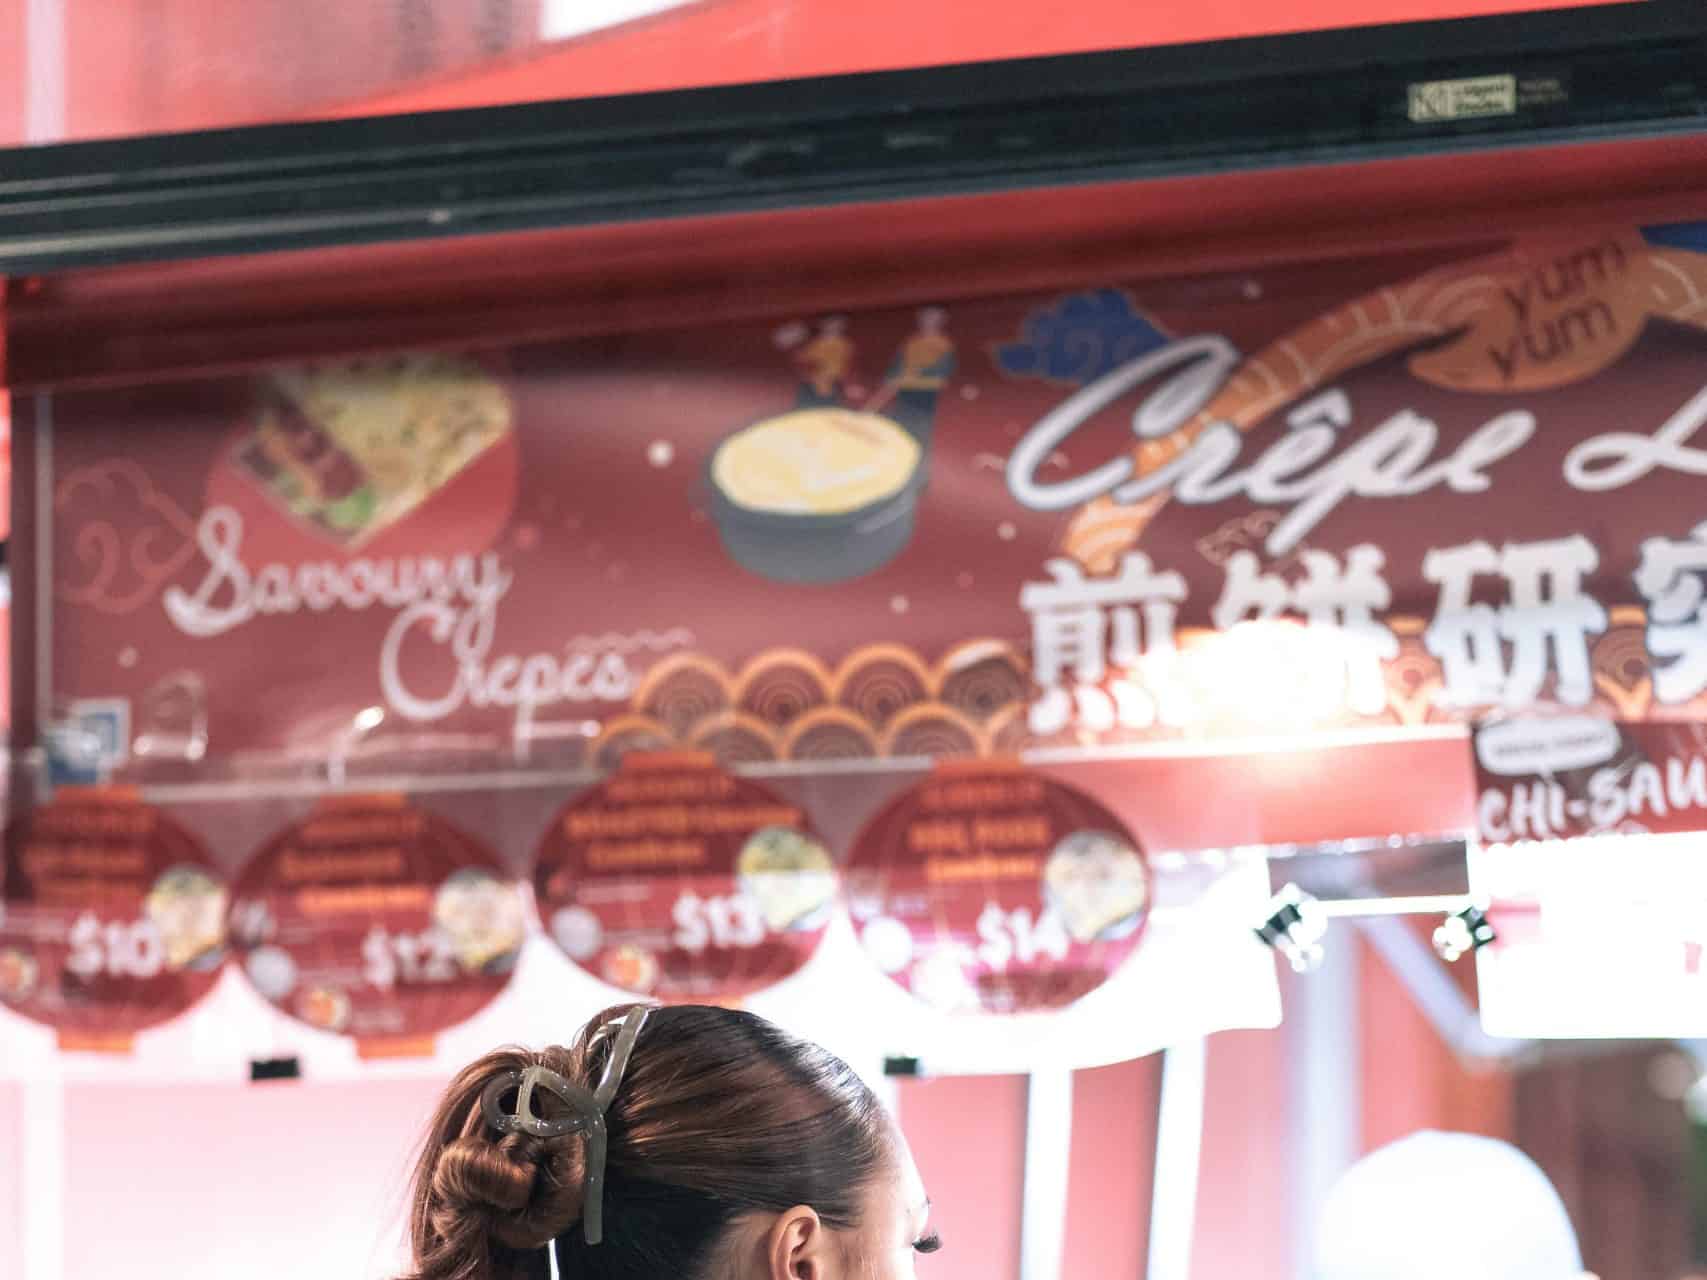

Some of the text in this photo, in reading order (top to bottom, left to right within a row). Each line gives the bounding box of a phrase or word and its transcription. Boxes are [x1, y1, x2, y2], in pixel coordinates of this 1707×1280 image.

[1006, 336, 1535, 557] Crêpe
[164, 507, 510, 652] Savoury
[381, 602, 632, 758] Crepes
[67, 910, 163, 982] $10
[977, 899, 1070, 969] $14
